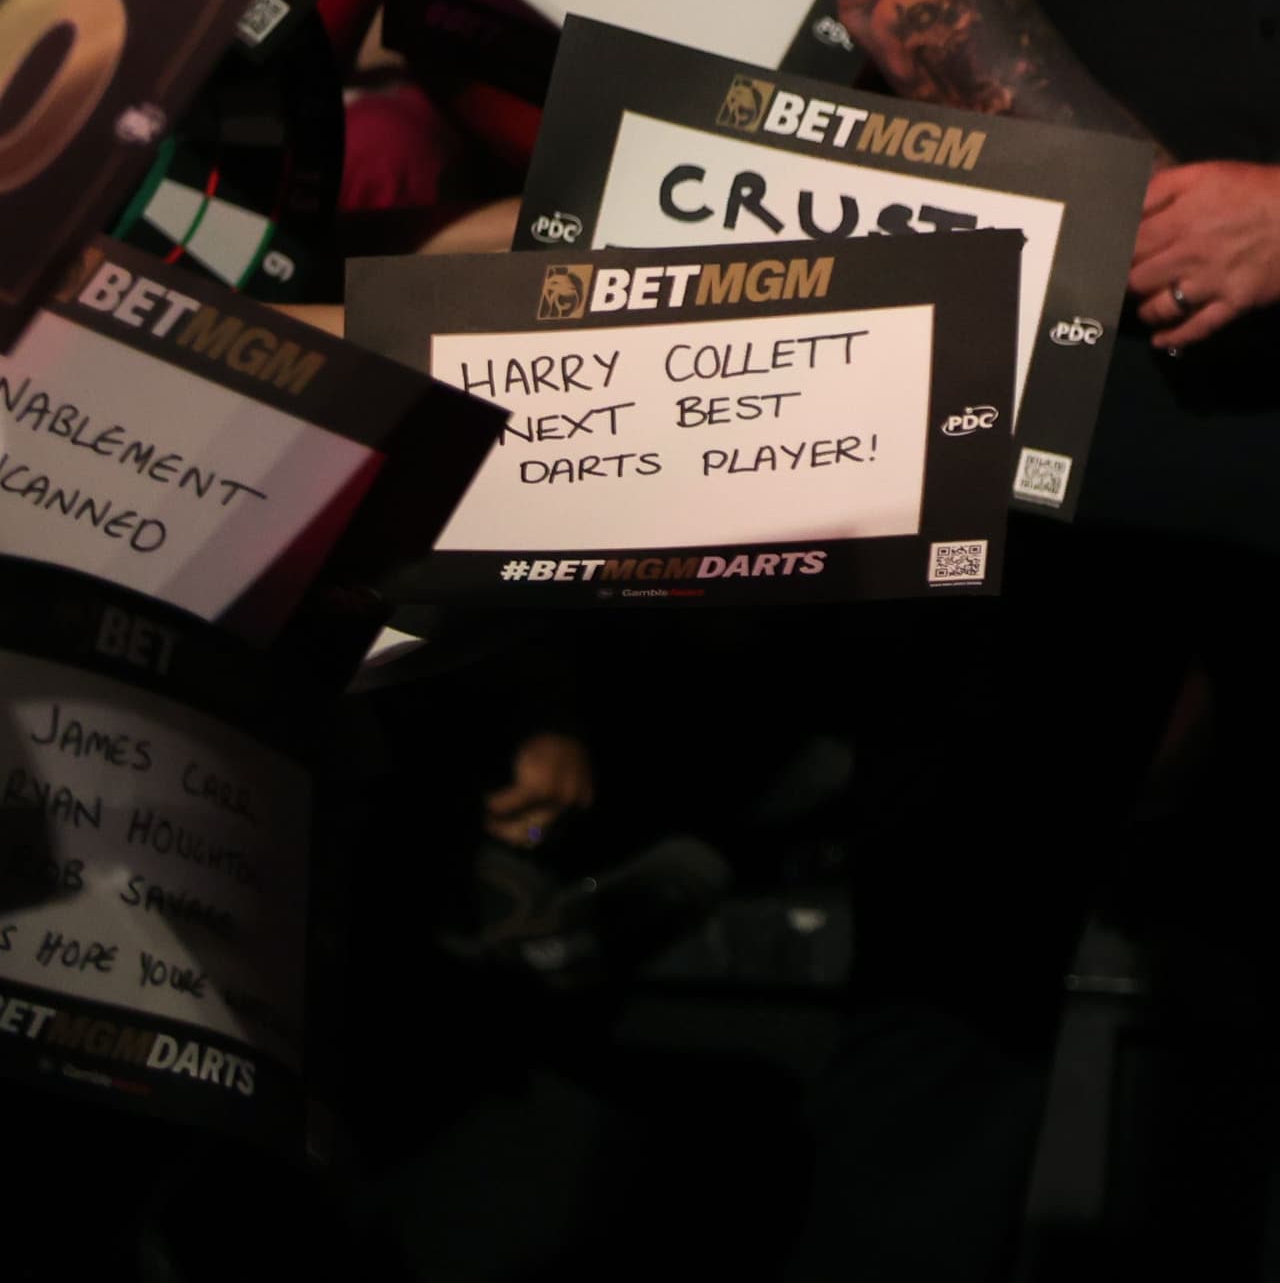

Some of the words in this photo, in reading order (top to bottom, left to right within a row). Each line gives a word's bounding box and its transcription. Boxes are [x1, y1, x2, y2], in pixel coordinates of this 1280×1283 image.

[763, 90, 987, 171] BETMGM
[531, 210, 583, 245] PDC
[660, 165, 985, 239] CRUST
[589, 256, 835, 314] BETMGM
[78, 262, 328, 396] BETMGM
[1049, 316, 1104, 347] PDC
[461, 350, 620, 397] HARRY
[665, 329, 870, 383] COLLETT
[497, 402, 637, 446] NEXT
[675, 392, 803, 428] BEST
[941, 405, 998, 436] PDC
[519, 451, 663, 485] DARTS
[702, 434, 878, 477] PLAYER!
[499, 549, 828, 585] #BETMGMDARTS
[31, 704, 153, 772] JAMES
[3, 767, 102, 830] RYAN
[36, 929, 119, 973] HOPE
